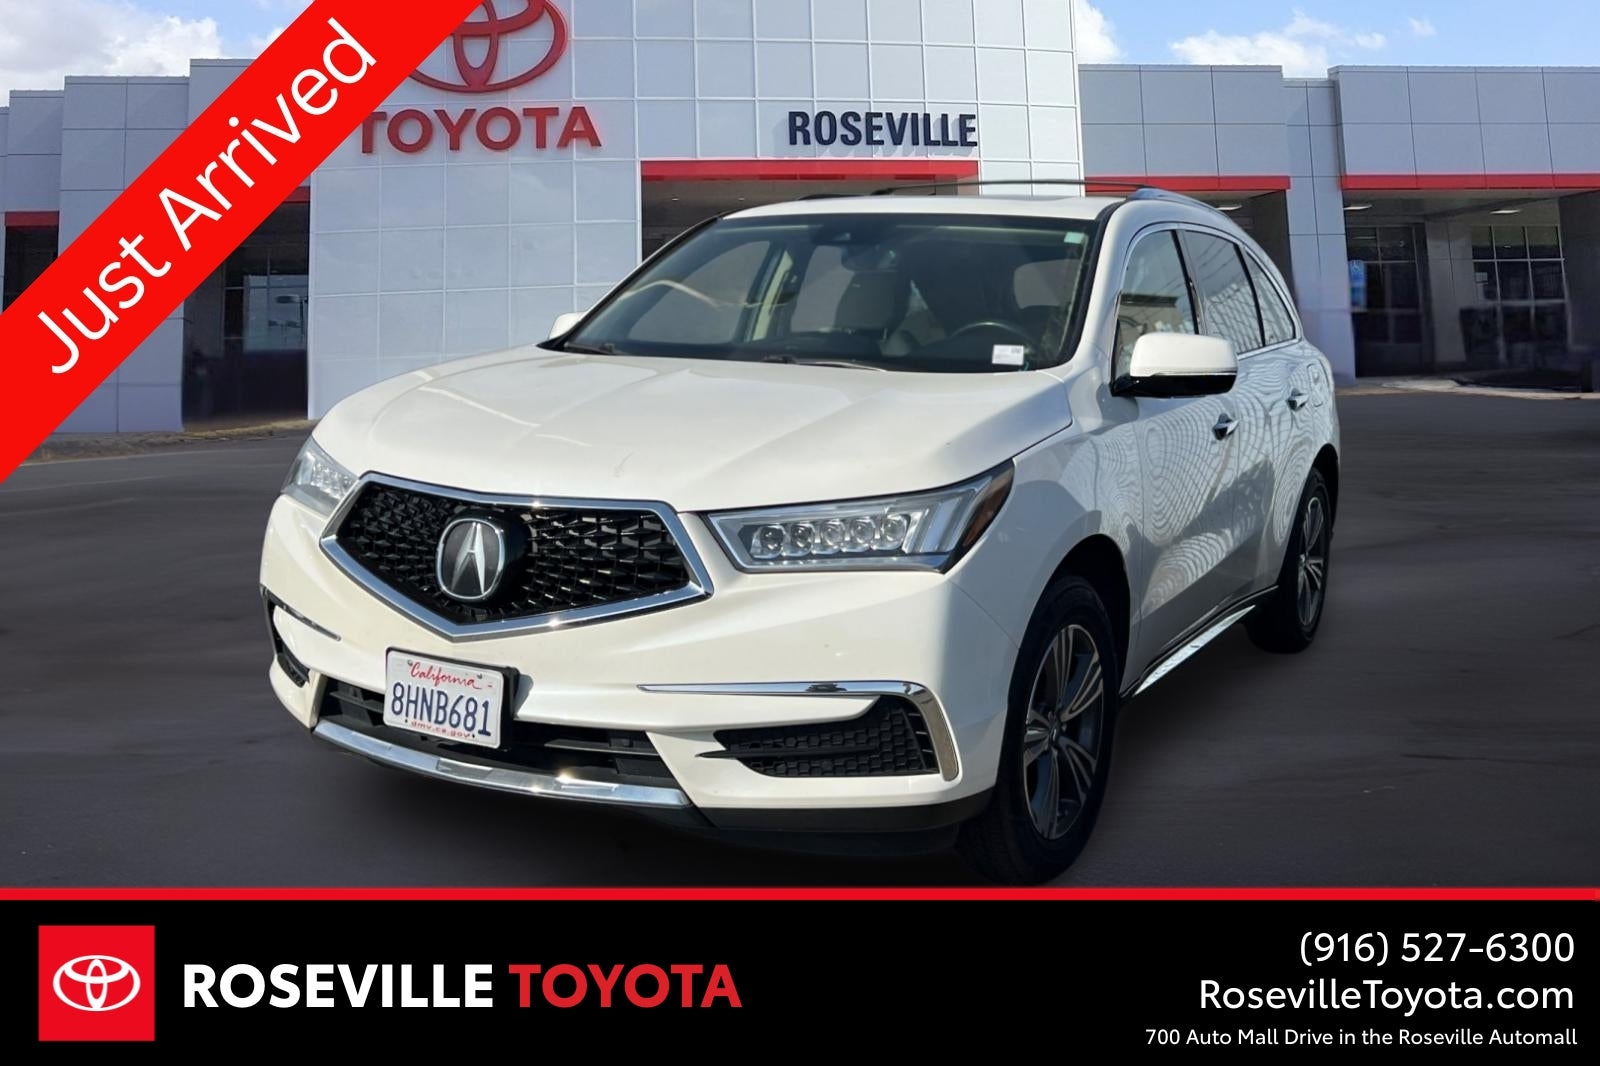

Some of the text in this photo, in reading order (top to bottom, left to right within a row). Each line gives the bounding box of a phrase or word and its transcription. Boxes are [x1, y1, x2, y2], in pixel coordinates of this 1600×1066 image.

[361, 106, 602, 154] TOYOTA
[788, 111, 978, 147] ROSEVILLE
[410, 662, 482, 690] California
[391, 682, 491, 737] 8HNB681
[411, 720, 471, 738] dmv.ca.gov
